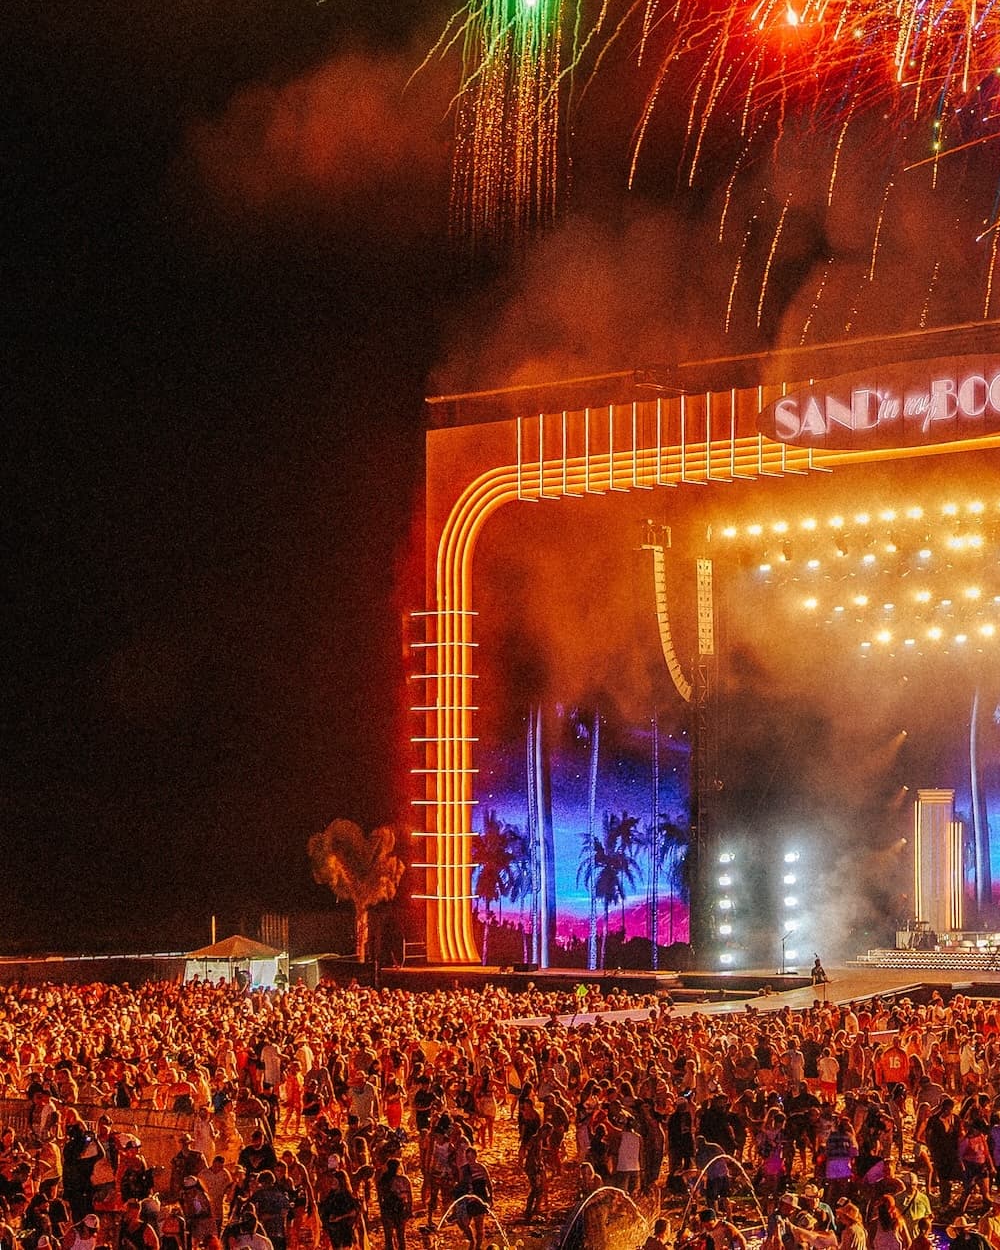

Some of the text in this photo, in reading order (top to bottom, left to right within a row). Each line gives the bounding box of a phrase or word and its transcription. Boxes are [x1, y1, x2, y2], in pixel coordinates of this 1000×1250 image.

[774, 388, 882, 439] SAND
[879, 393, 899, 419] in
[904, 391, 937, 433] my
[889, 1056, 901, 1068] 16
